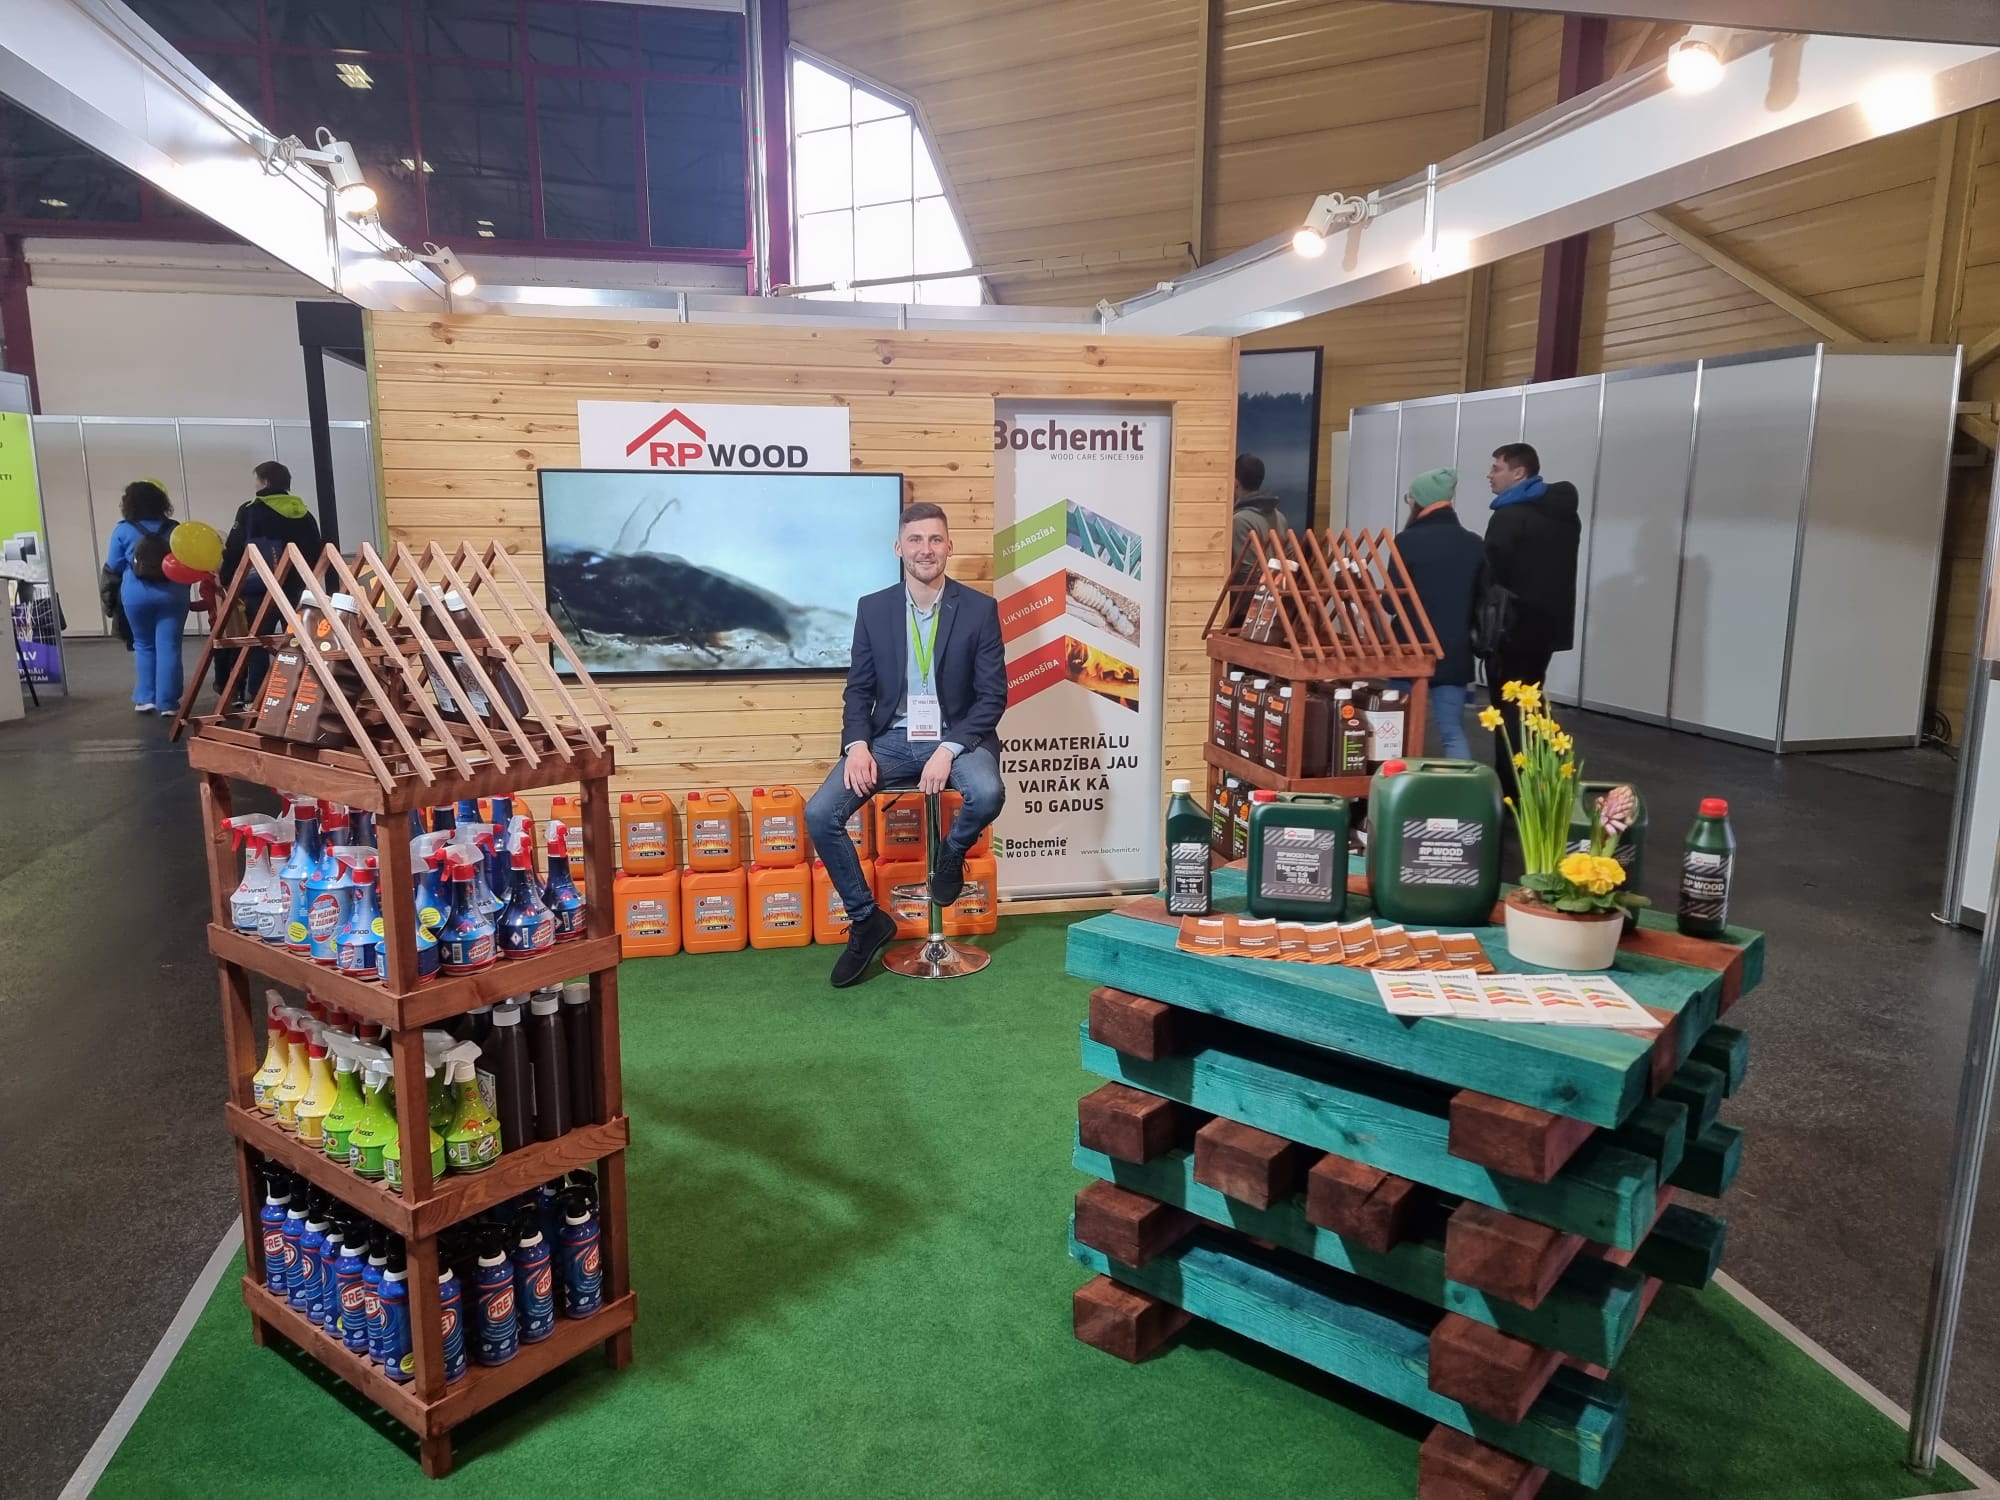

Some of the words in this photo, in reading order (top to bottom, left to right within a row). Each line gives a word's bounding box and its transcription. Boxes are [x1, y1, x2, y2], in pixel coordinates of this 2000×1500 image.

[995, 420, 1144, 451] Bochemit
[649, 442, 703, 467] RP
[707, 444, 808, 468] WOOD
[1050, 453, 1074, 461] WOOD
[1002, 525, 1057, 558] AIZSARDZĪBA
[1002, 595, 1055, 626] LIKVIDĀCIJA
[1007, 659, 1060, 689] UNSDROŠĪBA
[1000, 733, 1130, 753] KOKMATERIĀLU
[1002, 754, 1101, 774] IZSARDZĪBA
[1107, 756, 1138, 769] JAU
[1018, 775, 1081, 793] VAIRĀK
[1086, 774, 1110, 791] KĀ
[1024, 801, 1043, 814] 50
[1048, 798, 1104, 812] GADUS
[1006, 837, 1067, 850] Bochemie
[1080, 847, 1140, 855] www.bochemit.eu
[1006, 850, 1037, 858] WOOD
[1040, 848, 1067, 857] CARE
[1433, 848, 1464, 856] WOOD
[1693, 881, 1725, 891] WOOD
[264, 1234, 283, 1249] PRE
[343, 1289, 364, 1305] PRE
